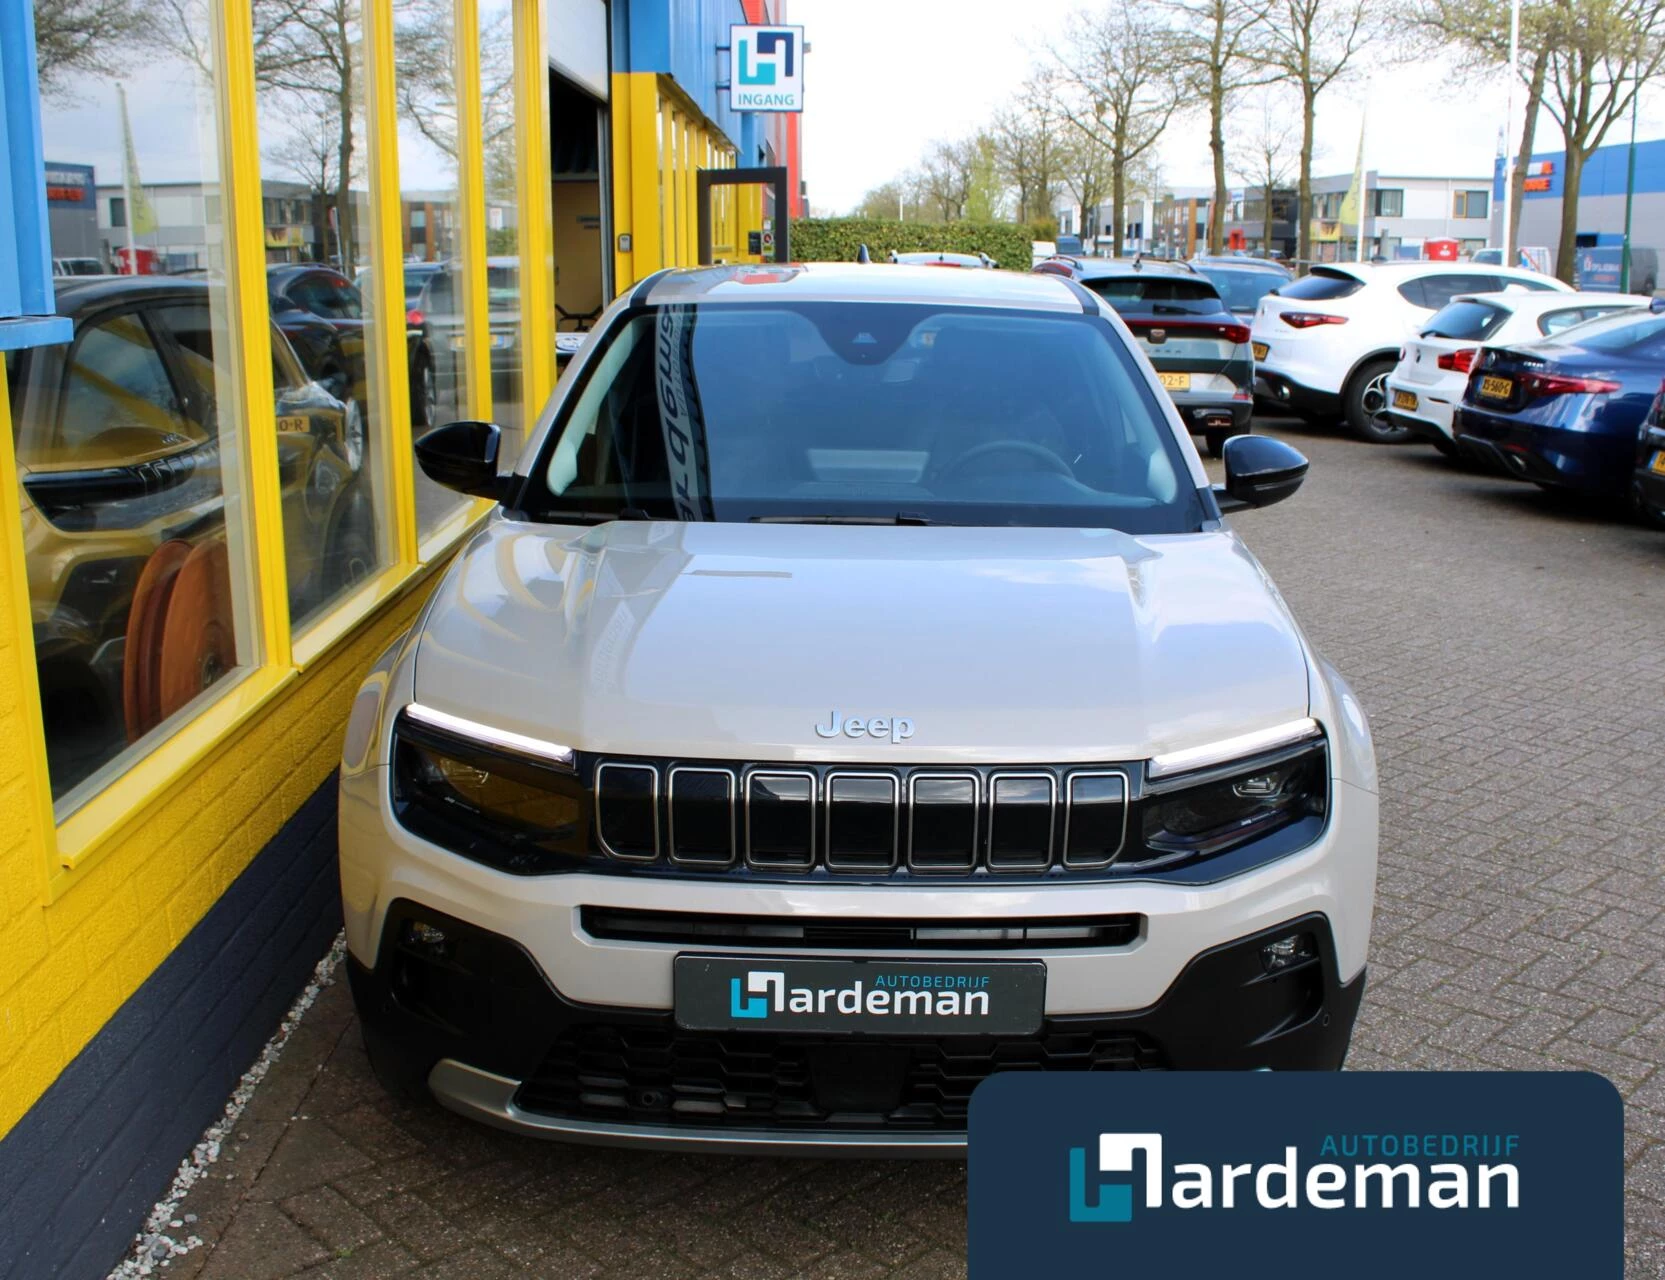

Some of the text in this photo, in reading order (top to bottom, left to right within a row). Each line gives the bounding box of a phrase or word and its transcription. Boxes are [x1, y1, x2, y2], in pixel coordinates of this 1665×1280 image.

[738, 94, 795, 106] INGANG
[815, 710, 915, 744] Jeep
[875, 974, 990, 991] AUTOBEDRIJF
